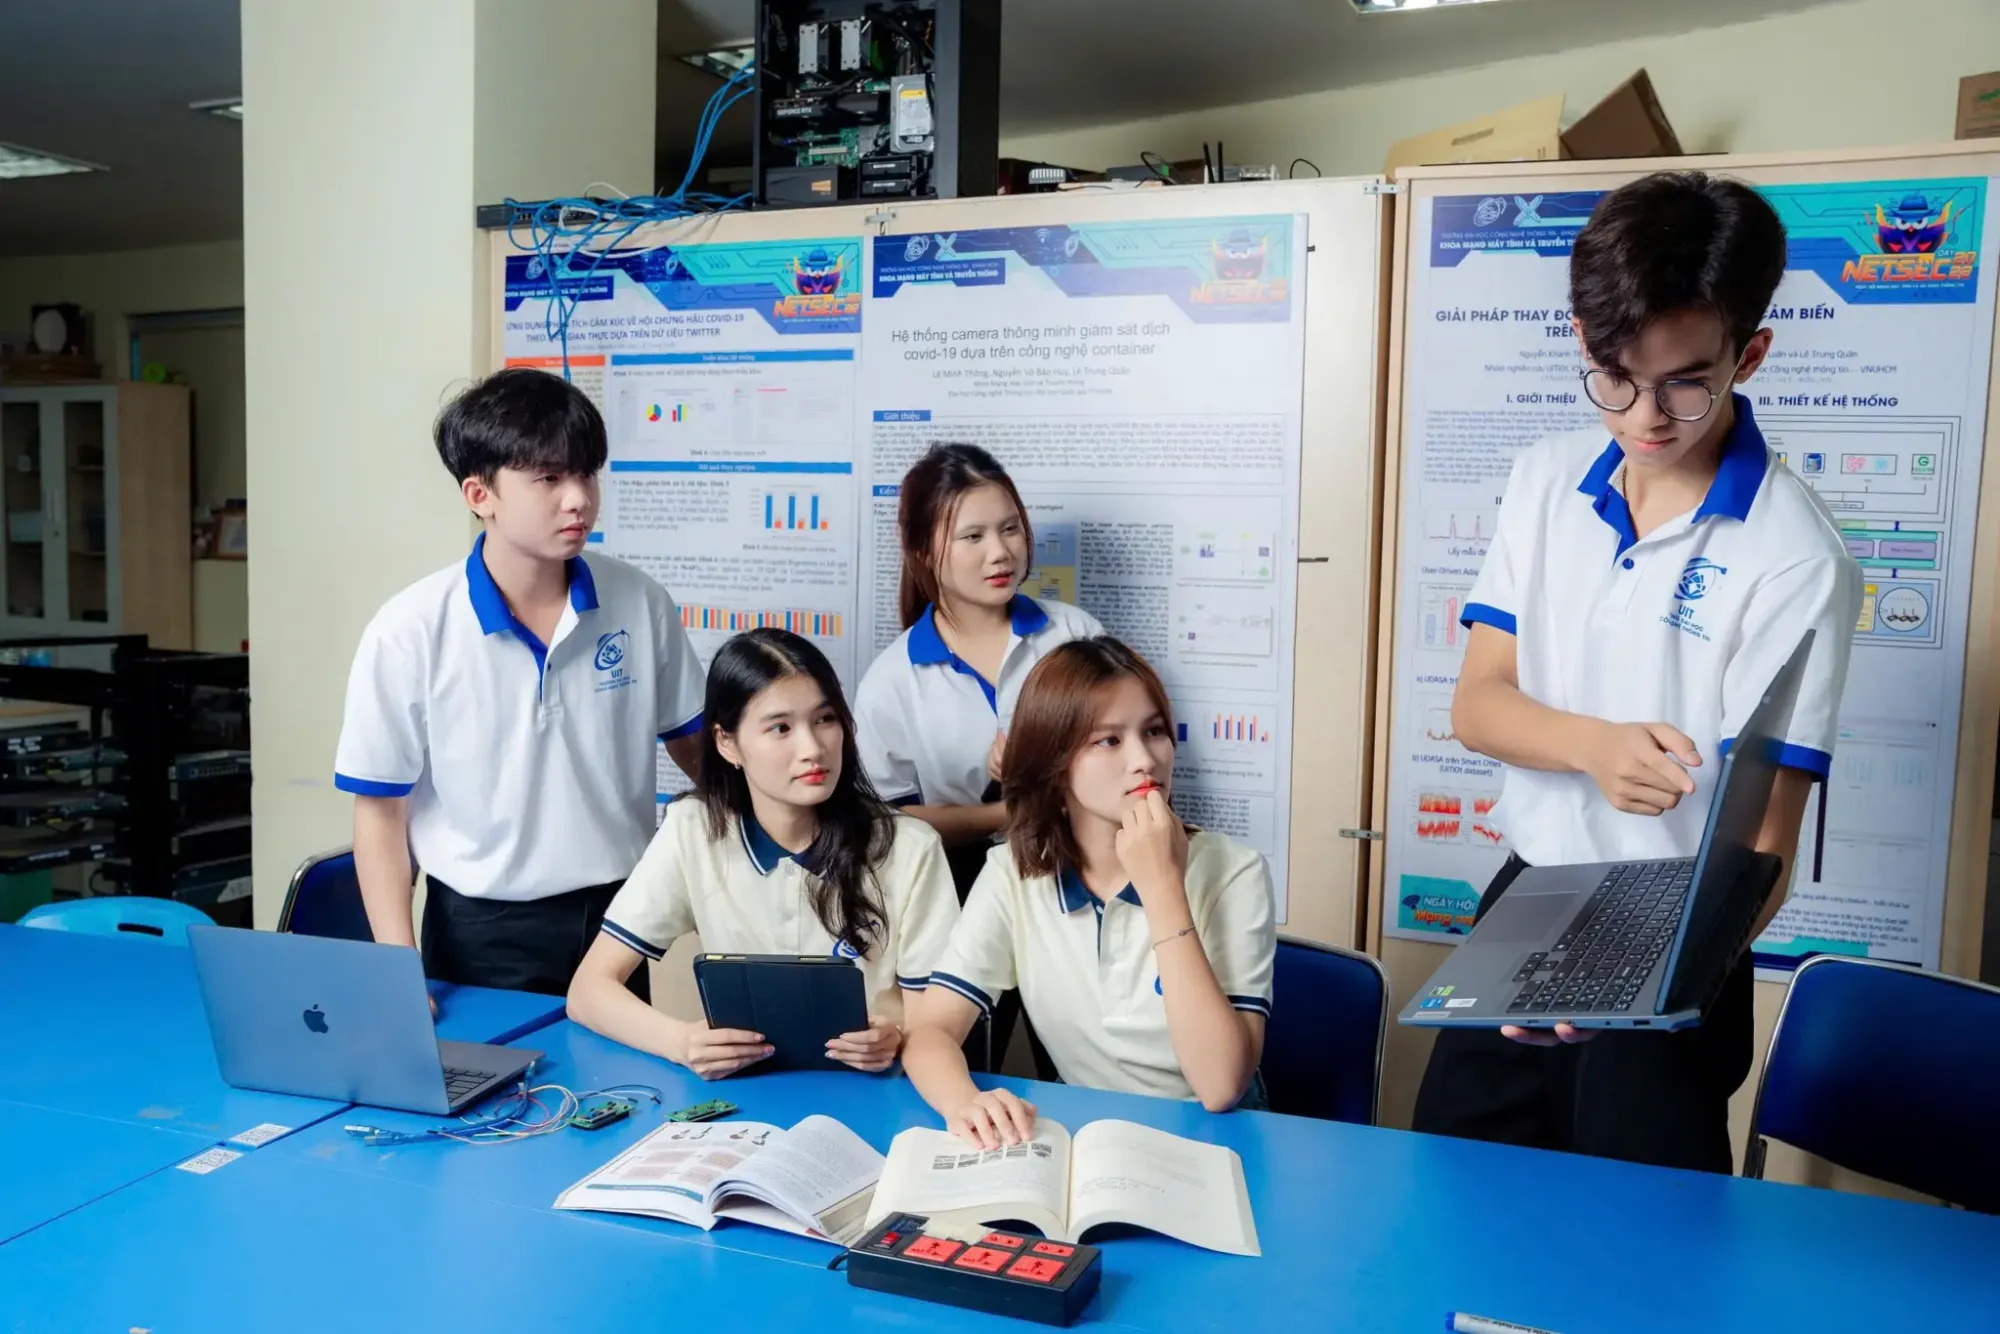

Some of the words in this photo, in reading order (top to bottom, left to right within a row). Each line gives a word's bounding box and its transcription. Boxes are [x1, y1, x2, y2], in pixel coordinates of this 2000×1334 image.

[1488, 239, 1505, 248] MÁY
[1507, 239, 1523, 247] TÍNH
[1525, 239, 1536, 247] VÀ
[1538, 236, 1565, 247] TRUYỀN
[945, 270, 954, 279] VÀ
[1841, 254, 1951, 282] NETSEC
[773, 295, 846, 318] NETSEC
[1762, 303, 1794, 320] ẢM
[1800, 303, 1834, 320] BIẾN
[610, 315, 625, 326] XÚC
[638, 314, 653, 326] HỘI
[655, 313, 685, 325] CHỨNG
[706, 313, 744, 323] COVID-19
[1435, 306, 1466, 322] GIẢI
[1471, 307, 1509, 321] PHÁP
[1513, 310, 1549, 321] THAY
[526, 333, 546, 342] THEO
[568, 332, 586, 341] GIAN
[610, 330, 628, 341] DỰA
[630, 328, 650, 339] TRÊN
[666, 328, 684, 338] LIỆU
[685, 328, 720, 337] TWITTER
[891, 329, 909, 344] Hệ
[913, 324, 948, 344] thống
[951, 328, 999, 341] camera
[1003, 326, 1039, 341] thông
[1043, 324, 1076, 338] minh
[1079, 323, 1113, 340] giám
[1117, 322, 1138, 336] sát
[1141, 321, 1170, 338] dịch
[904, 346, 957, 360] covid-19
[960, 346, 986, 360] dựa
[990, 345, 1015, 358] trên
[1018, 344, 1050, 360] công
[1054, 343, 1088, 359] nghệ
[1092, 341, 1156, 356] container
[1519, 350, 1547, 360] Nguyễn
[1799, 350, 1809, 358] Lê
[1812, 351, 1835, 359] Trung
[1837, 351, 1858, 359] Quân
[1507, 364, 1531, 373] nghiên
[1770, 365, 1789, 374] Công
[1791, 365, 1810, 374] nghệ
[1813, 365, 1836, 374] thông
[1838, 365, 1849, 373] tin
[1860, 365, 1897, 373] VNUHCM
[1506, 394, 1513, 404] I.
[1516, 392, 1542, 404] GIỚI
[1546, 393, 1577, 406] THIỆU
[1758, 396, 1774, 406] III.
[1778, 393, 1810, 406] THIẾT
[1813, 392, 1831, 406] KẾ
[1832, 394, 1848, 409] HỆ
[1851, 393, 1899, 407] THỐNG
[884, 412, 898, 420] Giới
[901, 412, 920, 421] thiệu
[1678, 603, 1695, 619] UIT
[611, 668, 623, 678] UIT
[1424, 676, 1448, 684] UDASA
[1412, 753, 1419, 762] b)
[1420, 754, 1444, 763] UDASA
[1461, 757, 1482, 767] Smart
[1483, 759, 1502, 768] Cities
[1464, 766, 1493, 777] dataset)
[1424, 894, 1453, 909] NGÀY
[1456, 896, 1475, 911] HỘI
